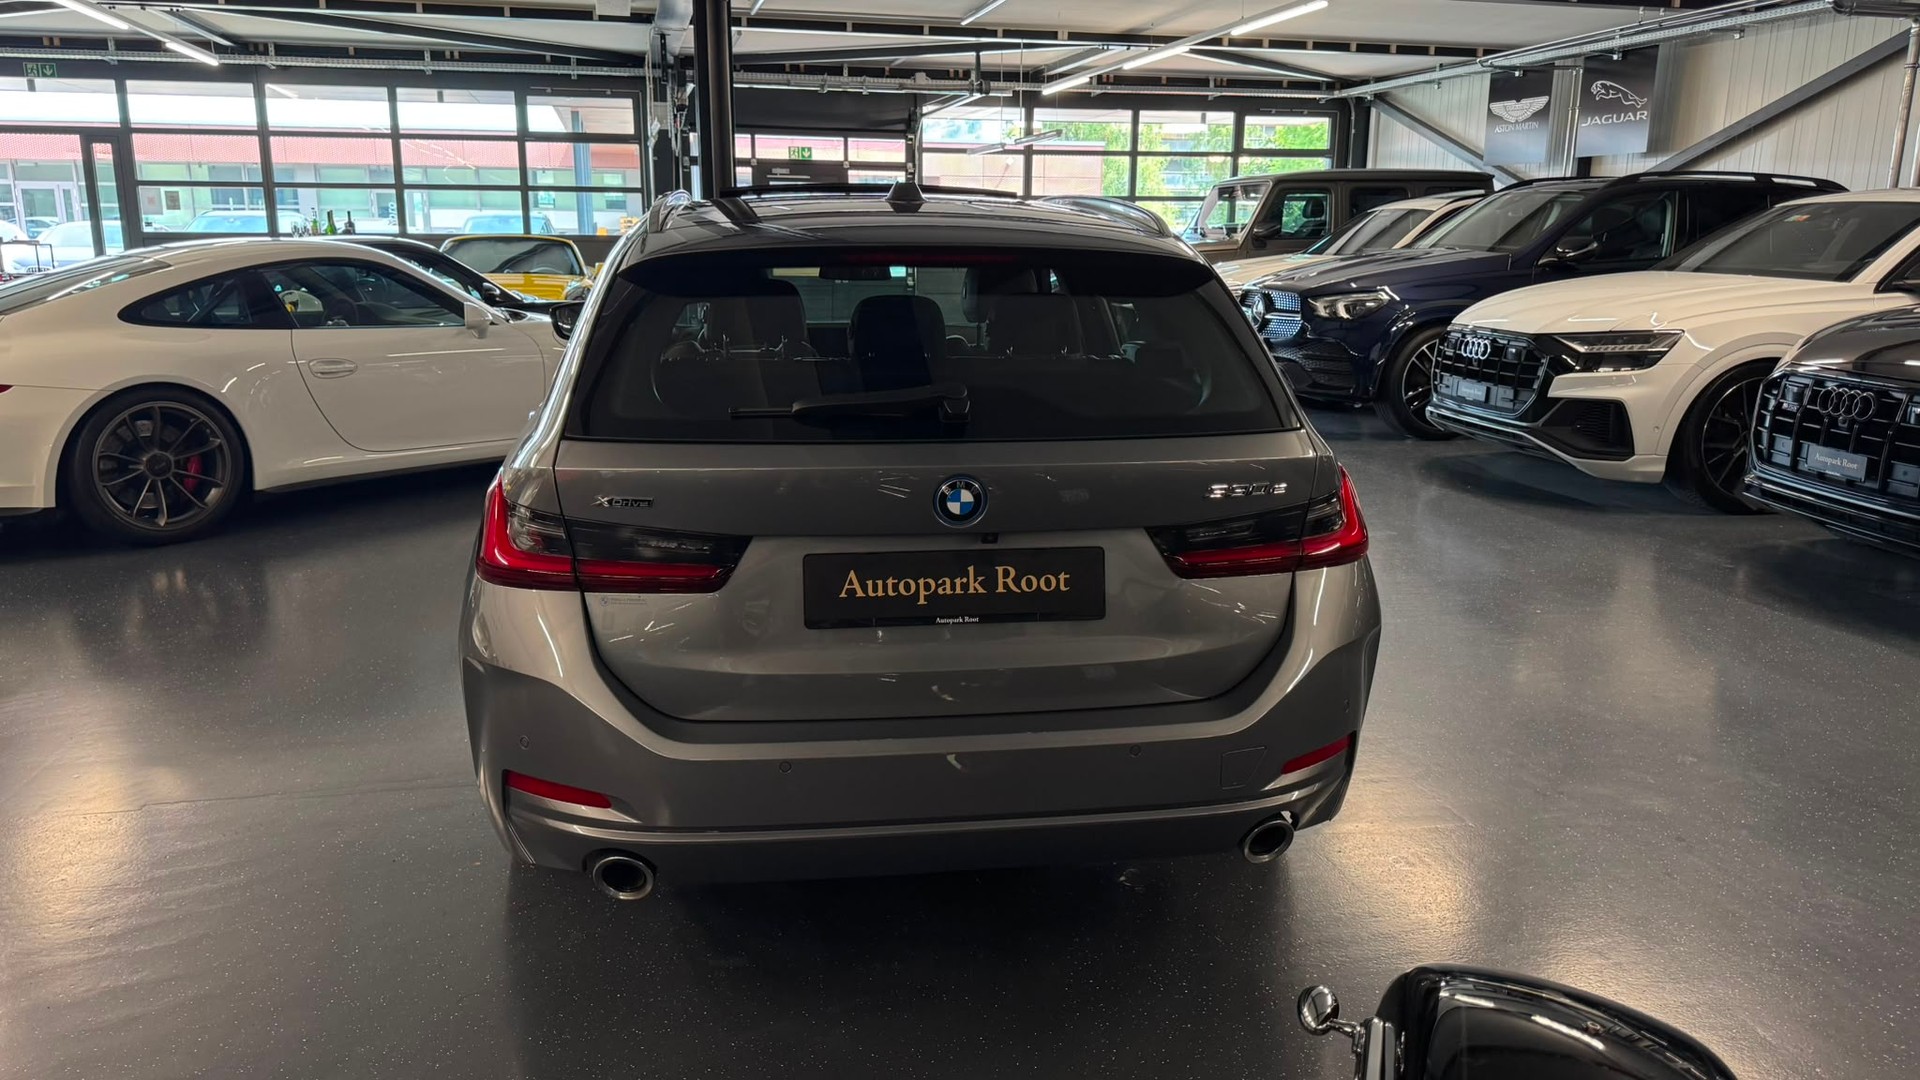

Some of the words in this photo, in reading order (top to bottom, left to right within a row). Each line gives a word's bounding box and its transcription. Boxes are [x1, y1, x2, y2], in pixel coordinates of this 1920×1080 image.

[1581, 110, 1648, 127] JAGUAR
[1494, 124, 1515, 133] ASTON
[1515, 121, 1540, 131] MARTIN
[838, 565, 987, 605] Autopark
[994, 565, 1071, 594] Root
[935, 616, 963, 625] Autopark
